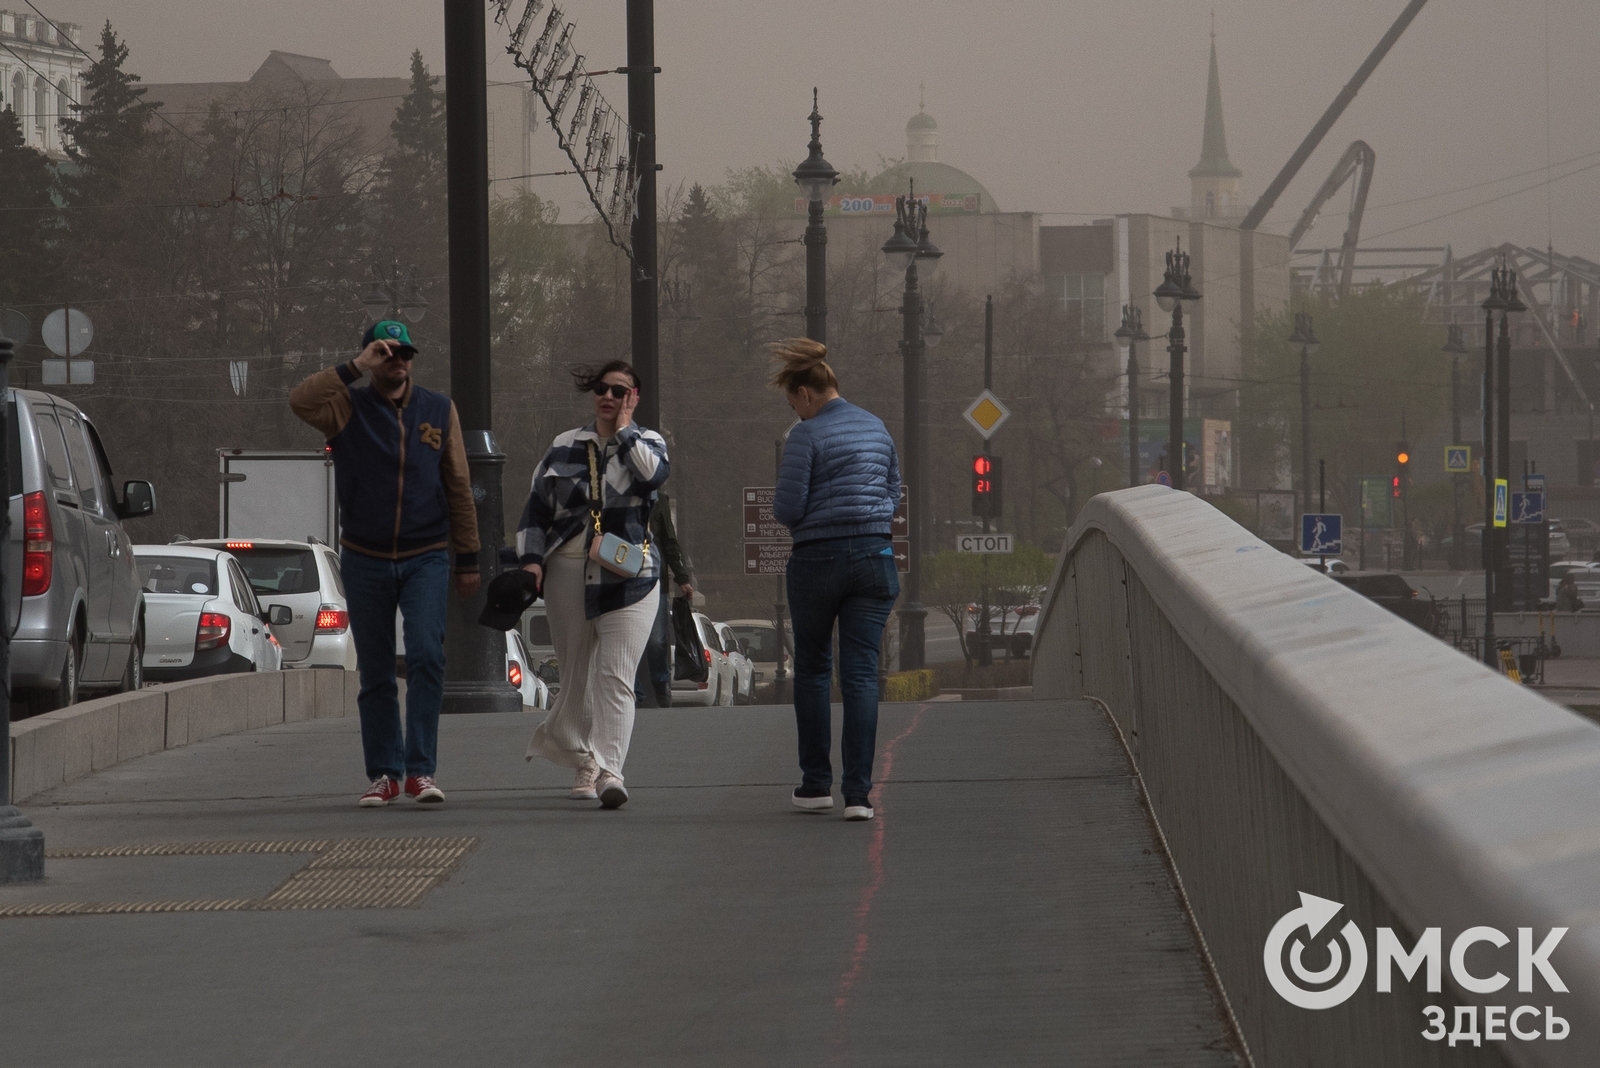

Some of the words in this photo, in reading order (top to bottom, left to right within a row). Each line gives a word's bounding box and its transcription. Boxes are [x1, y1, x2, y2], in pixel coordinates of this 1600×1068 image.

[841, 197, 874, 213] 200
[419, 422, 442, 451] 25
[961, 537, 1008, 551] СТОП
